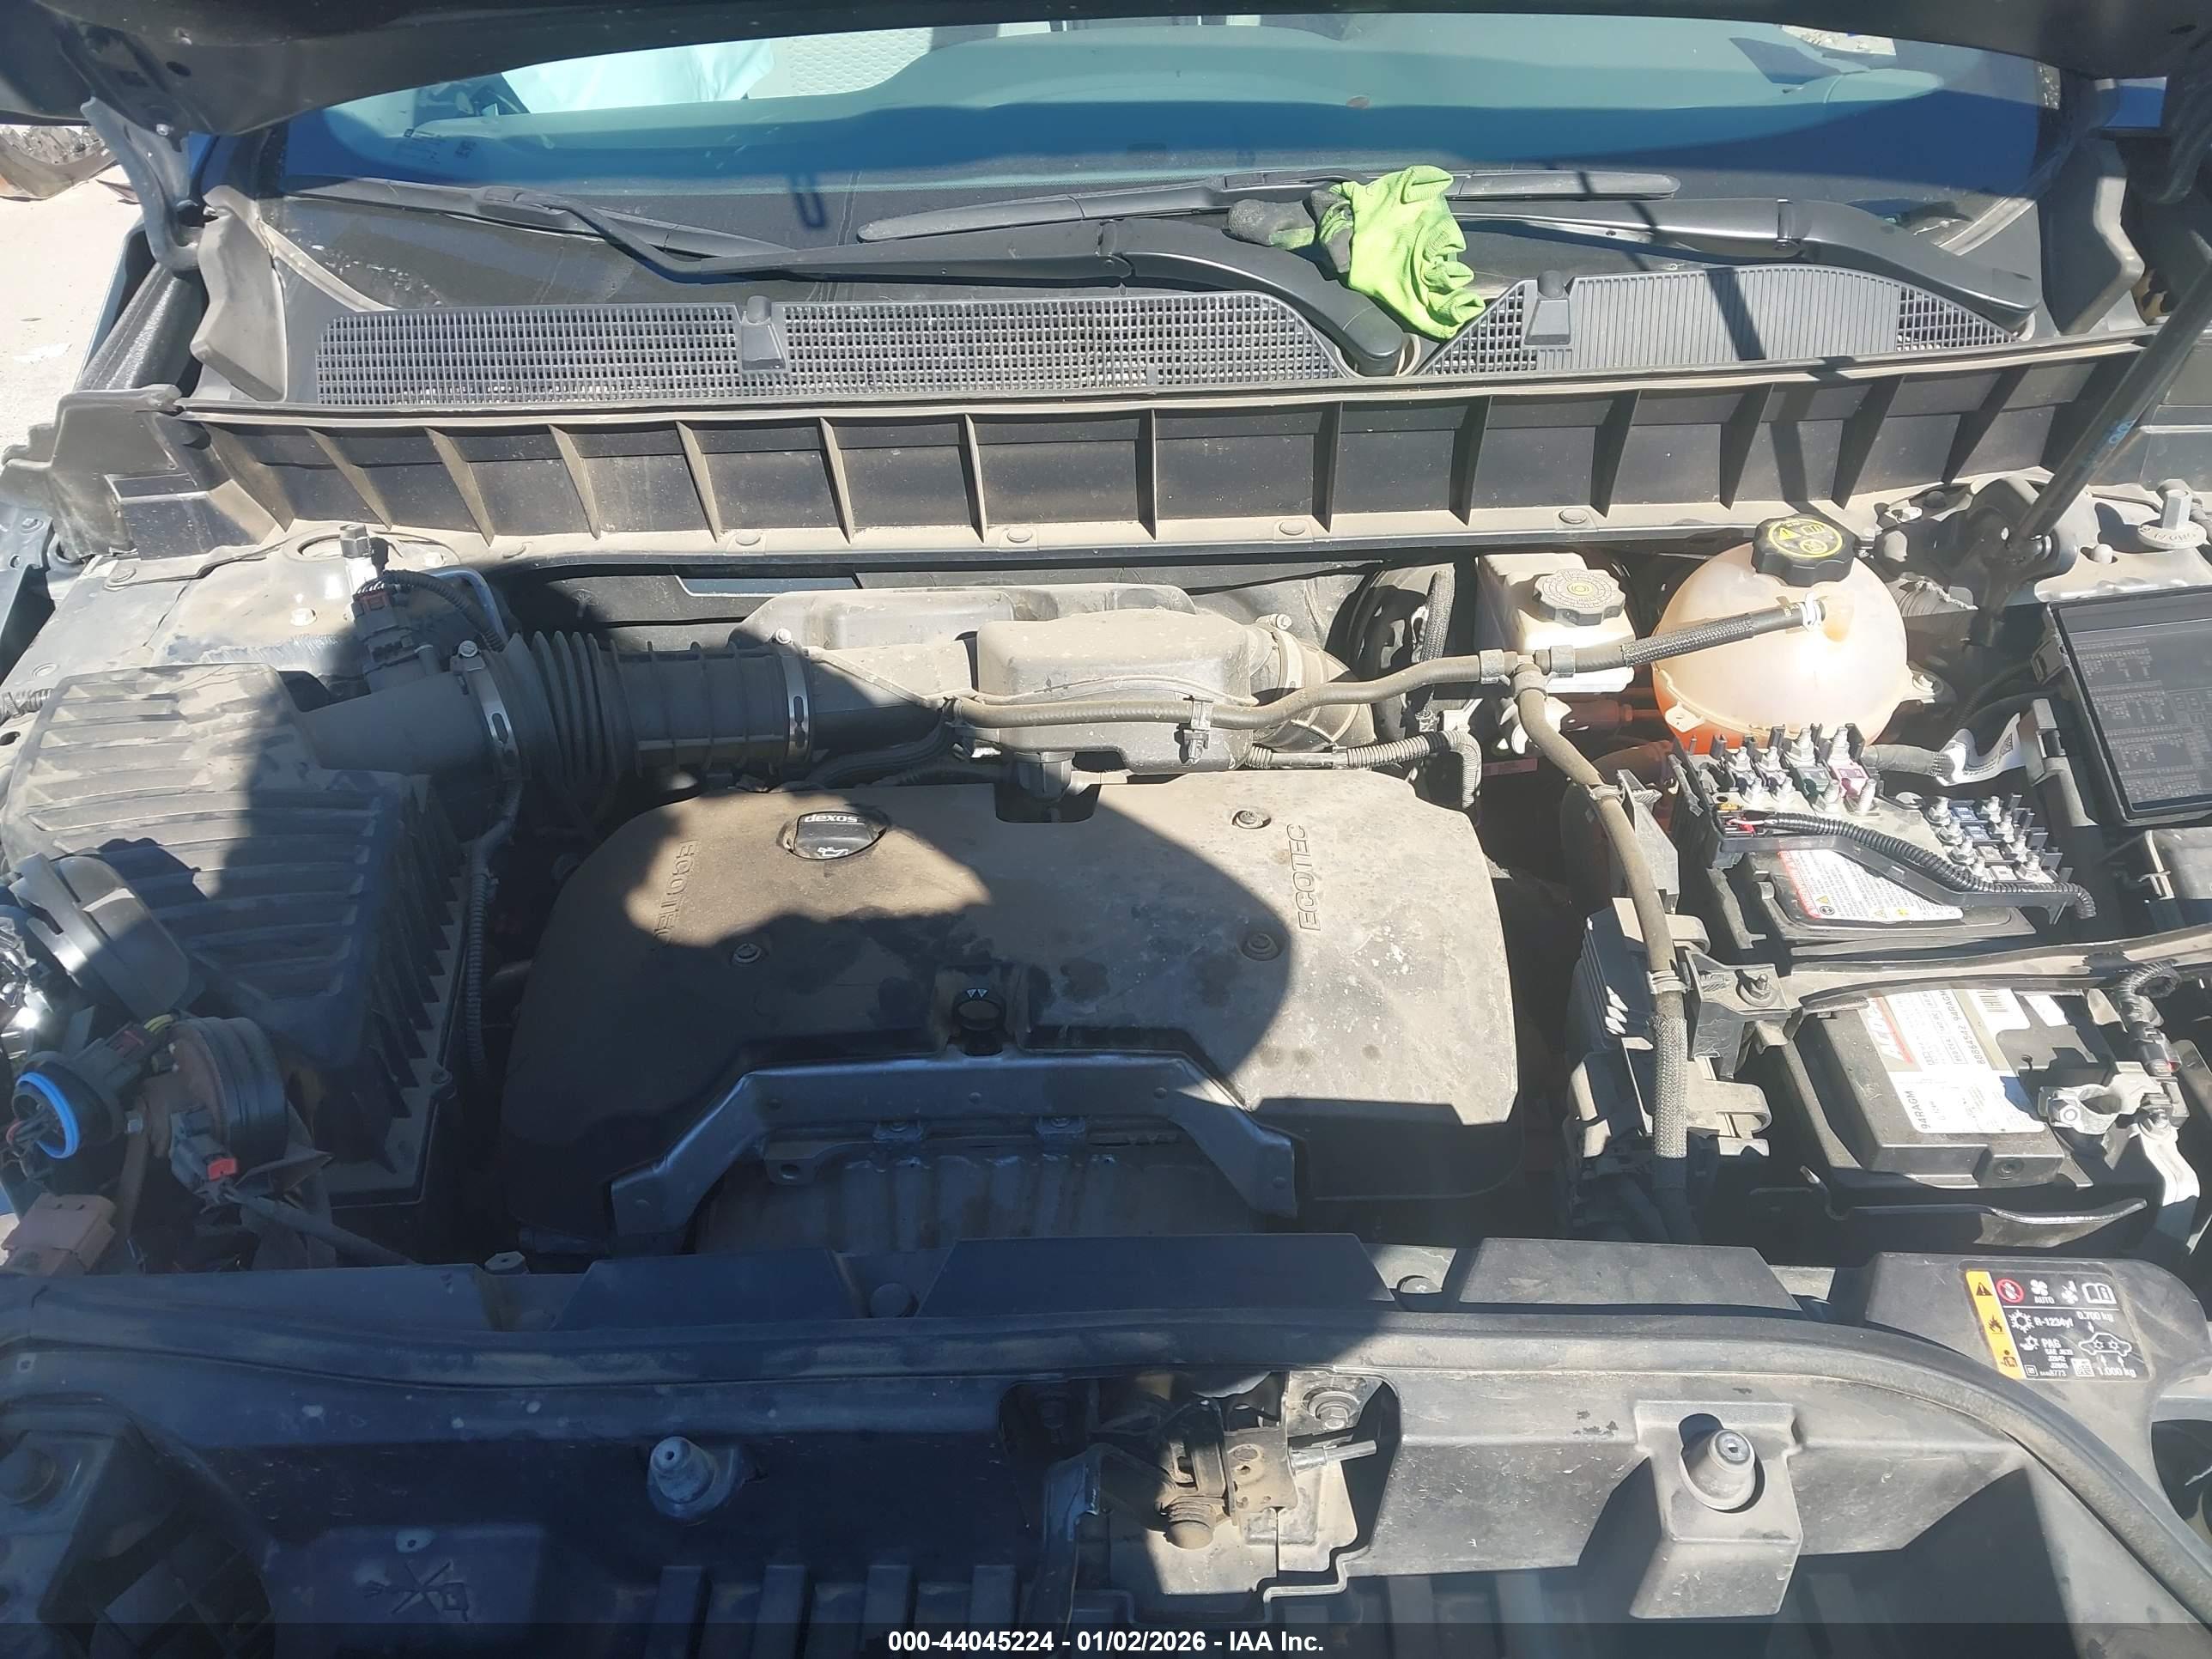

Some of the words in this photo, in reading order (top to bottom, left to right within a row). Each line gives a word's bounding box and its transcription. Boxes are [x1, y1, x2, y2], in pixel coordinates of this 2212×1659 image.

[804, 814, 858, 823] dexos
[1286, 823, 1322, 932] ECOTEC
[1905, 1090, 1931, 1130] 94RAGM
[2033, 1296, 2056, 1304] AUTO
[2075, 1310, 2101, 1321] 0.700
[2101, 1312, 2115, 1322] kg
[2124, 1368, 2137, 1378] kg
